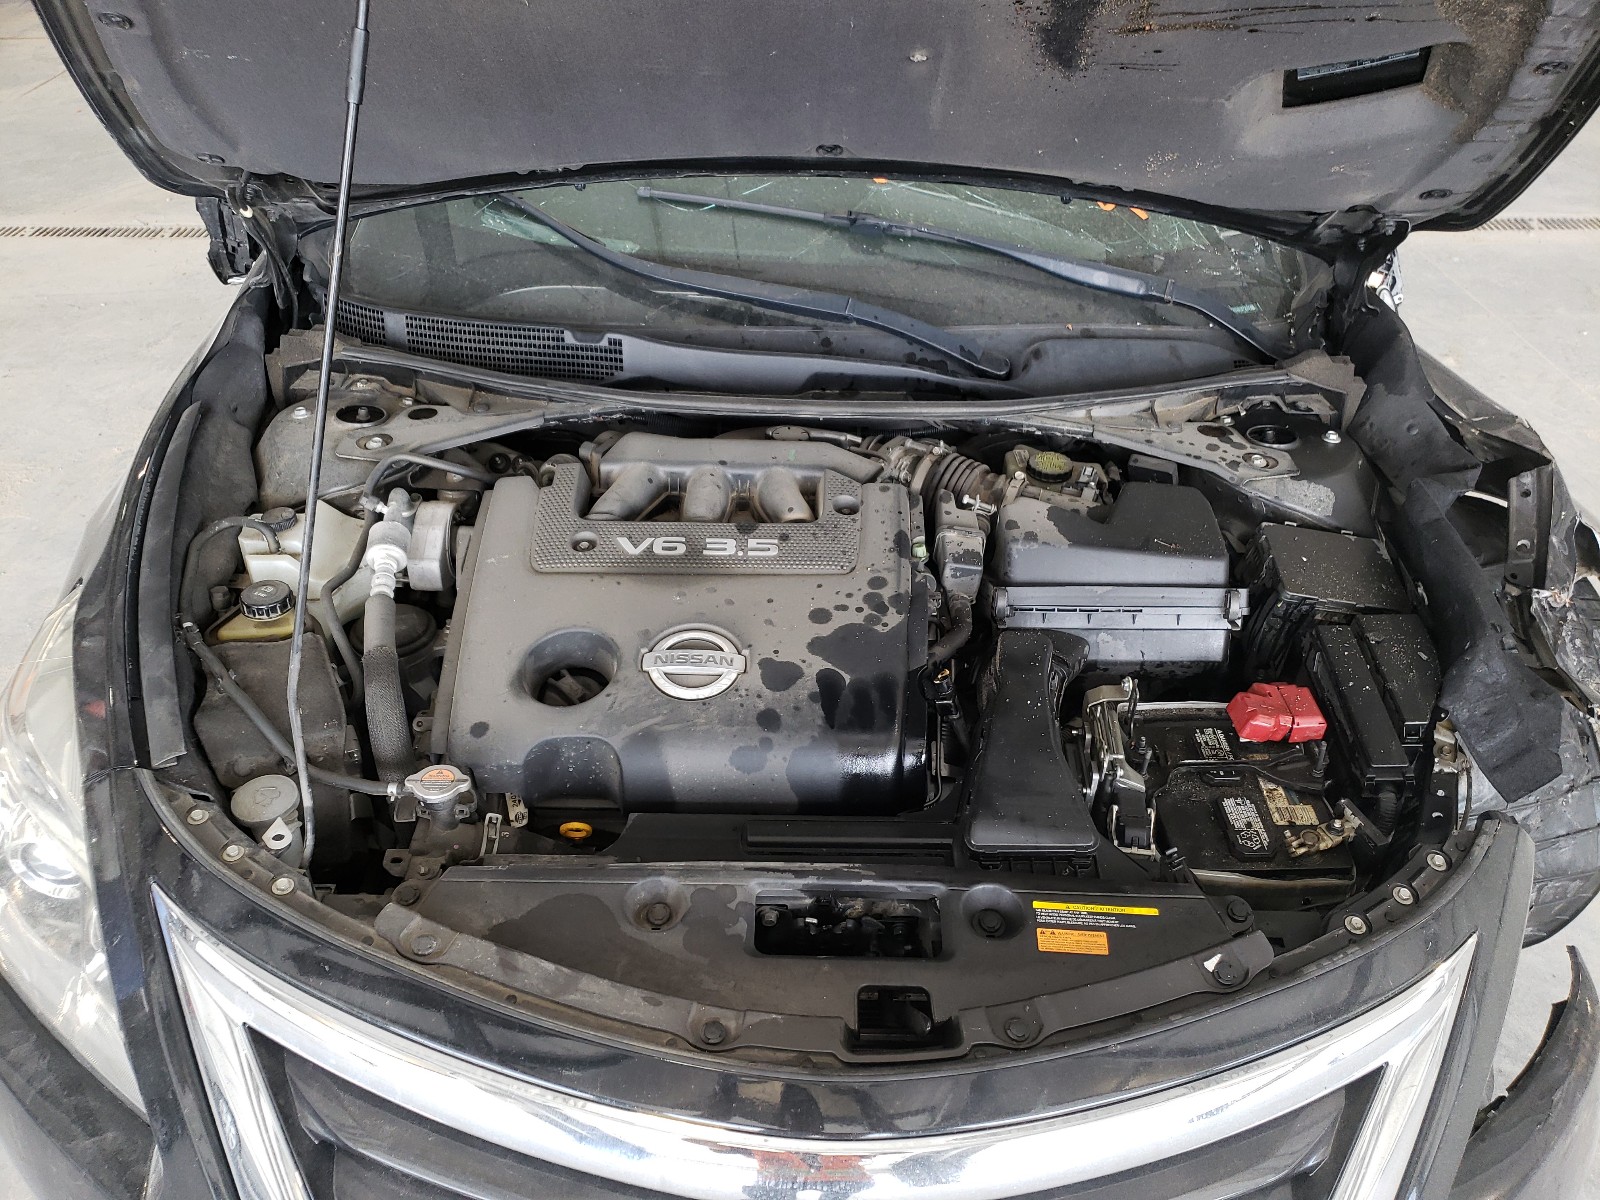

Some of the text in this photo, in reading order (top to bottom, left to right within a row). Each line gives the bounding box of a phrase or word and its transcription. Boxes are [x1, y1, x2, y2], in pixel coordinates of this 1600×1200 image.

[616, 536, 779, 557] V6 3.5
[653, 653, 734, 667] NISSAN
